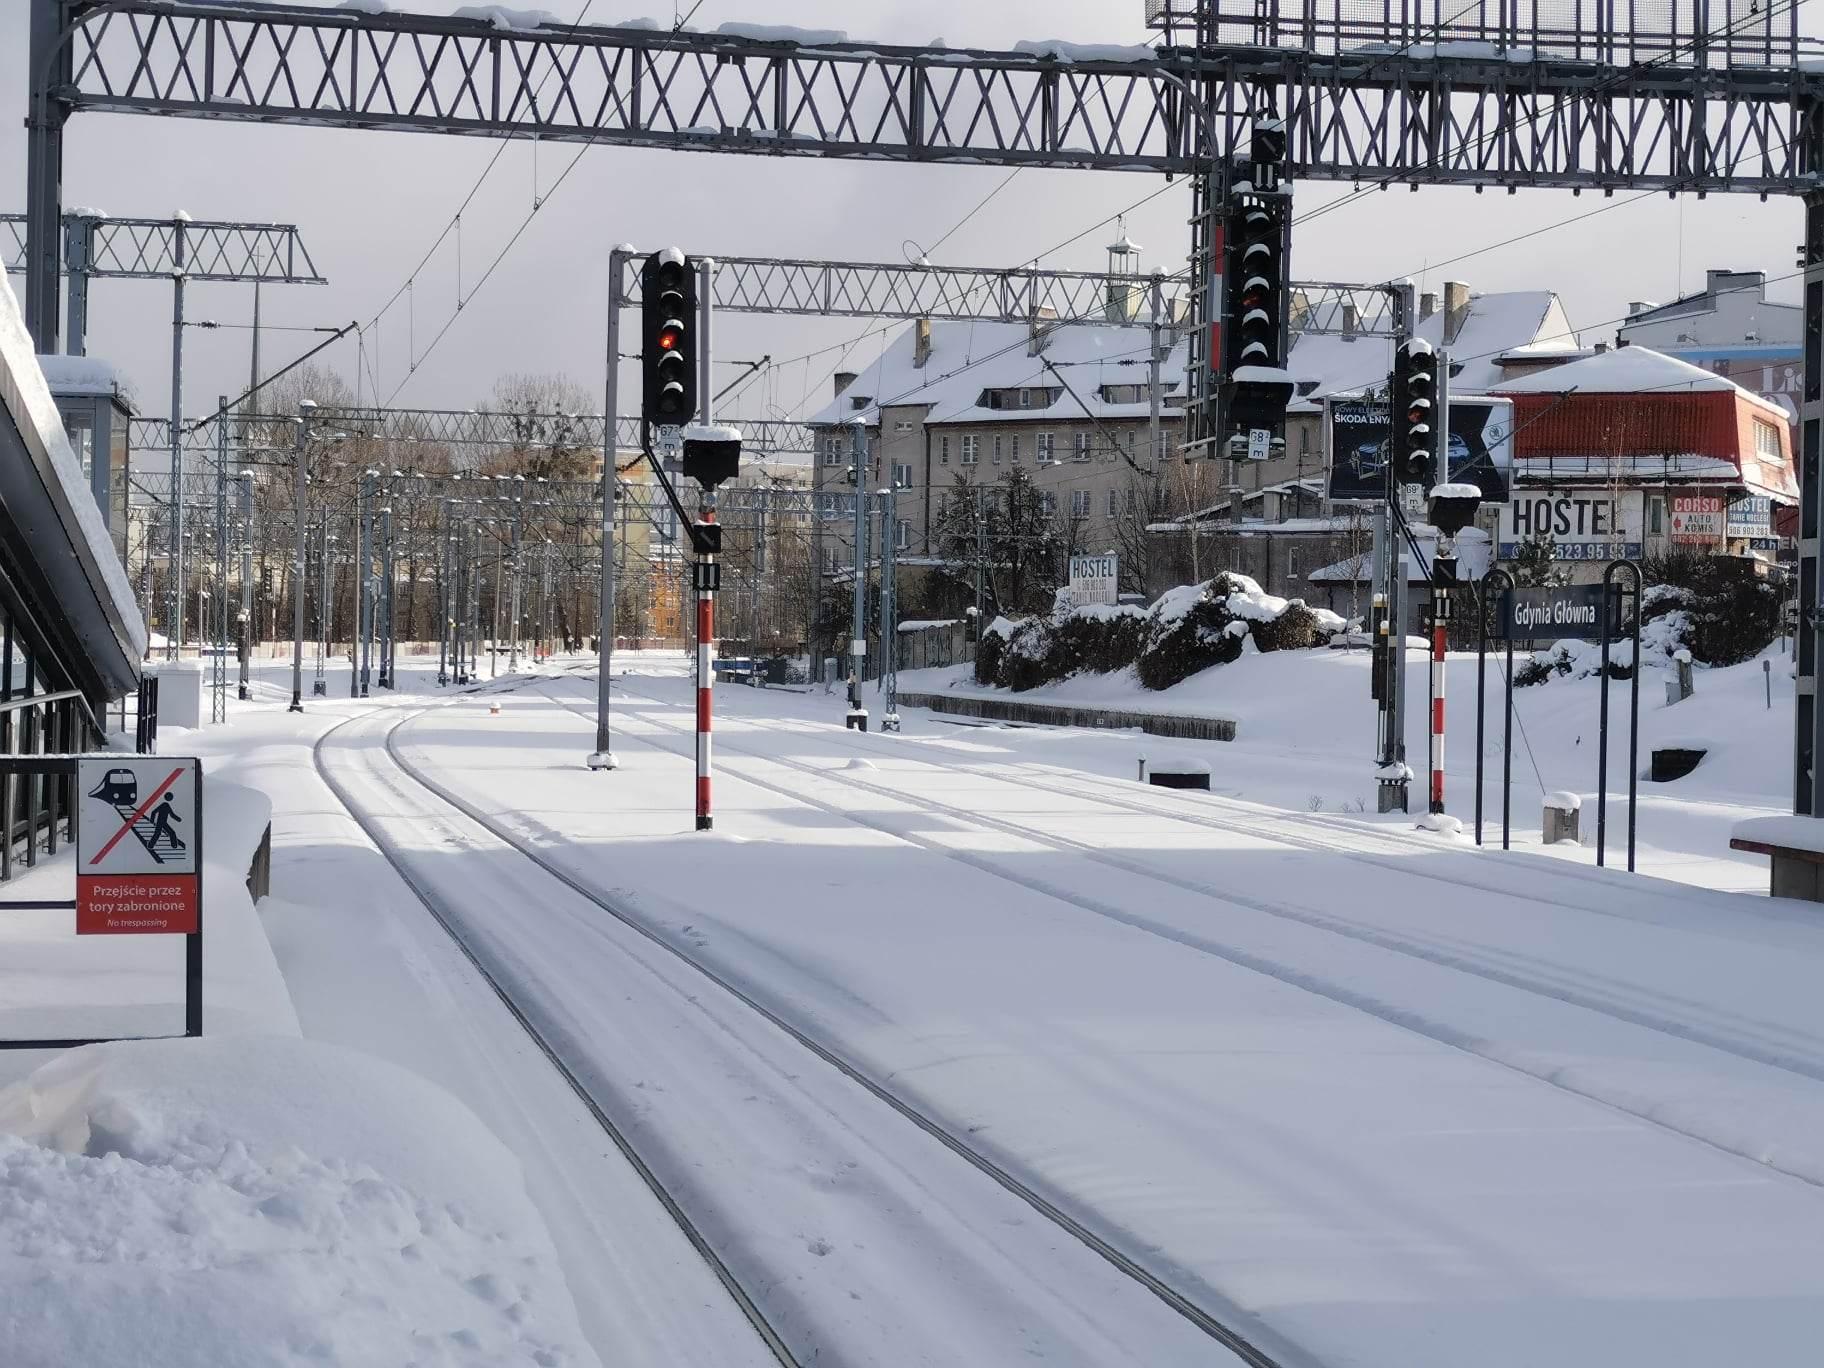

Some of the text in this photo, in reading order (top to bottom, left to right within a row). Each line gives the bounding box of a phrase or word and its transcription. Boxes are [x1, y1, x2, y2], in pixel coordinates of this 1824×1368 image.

[1335, 412, 1368, 423] ŠKODA
[1674, 497, 1719, 512] CORSO
[1729, 498, 1769, 512] HOSTEL
[1513, 499, 1625, 535] HOSTEL
[1687, 514, 1712, 524] AUTO
[1684, 523, 1714, 533] KOMIS
[1752, 539, 1776, 549] 24 h
[1555, 543, 1582, 560] 523
[1587, 543, 1604, 560] 95
[1073, 559, 1113, 578] HOSTEL
[1515, 601, 1595, 630] Gdynia Główna
[93, 885, 182, 897] Przejście przez
[90, 901, 185, 914] tory zabronione
[107, 918, 168, 929] No trespassing
